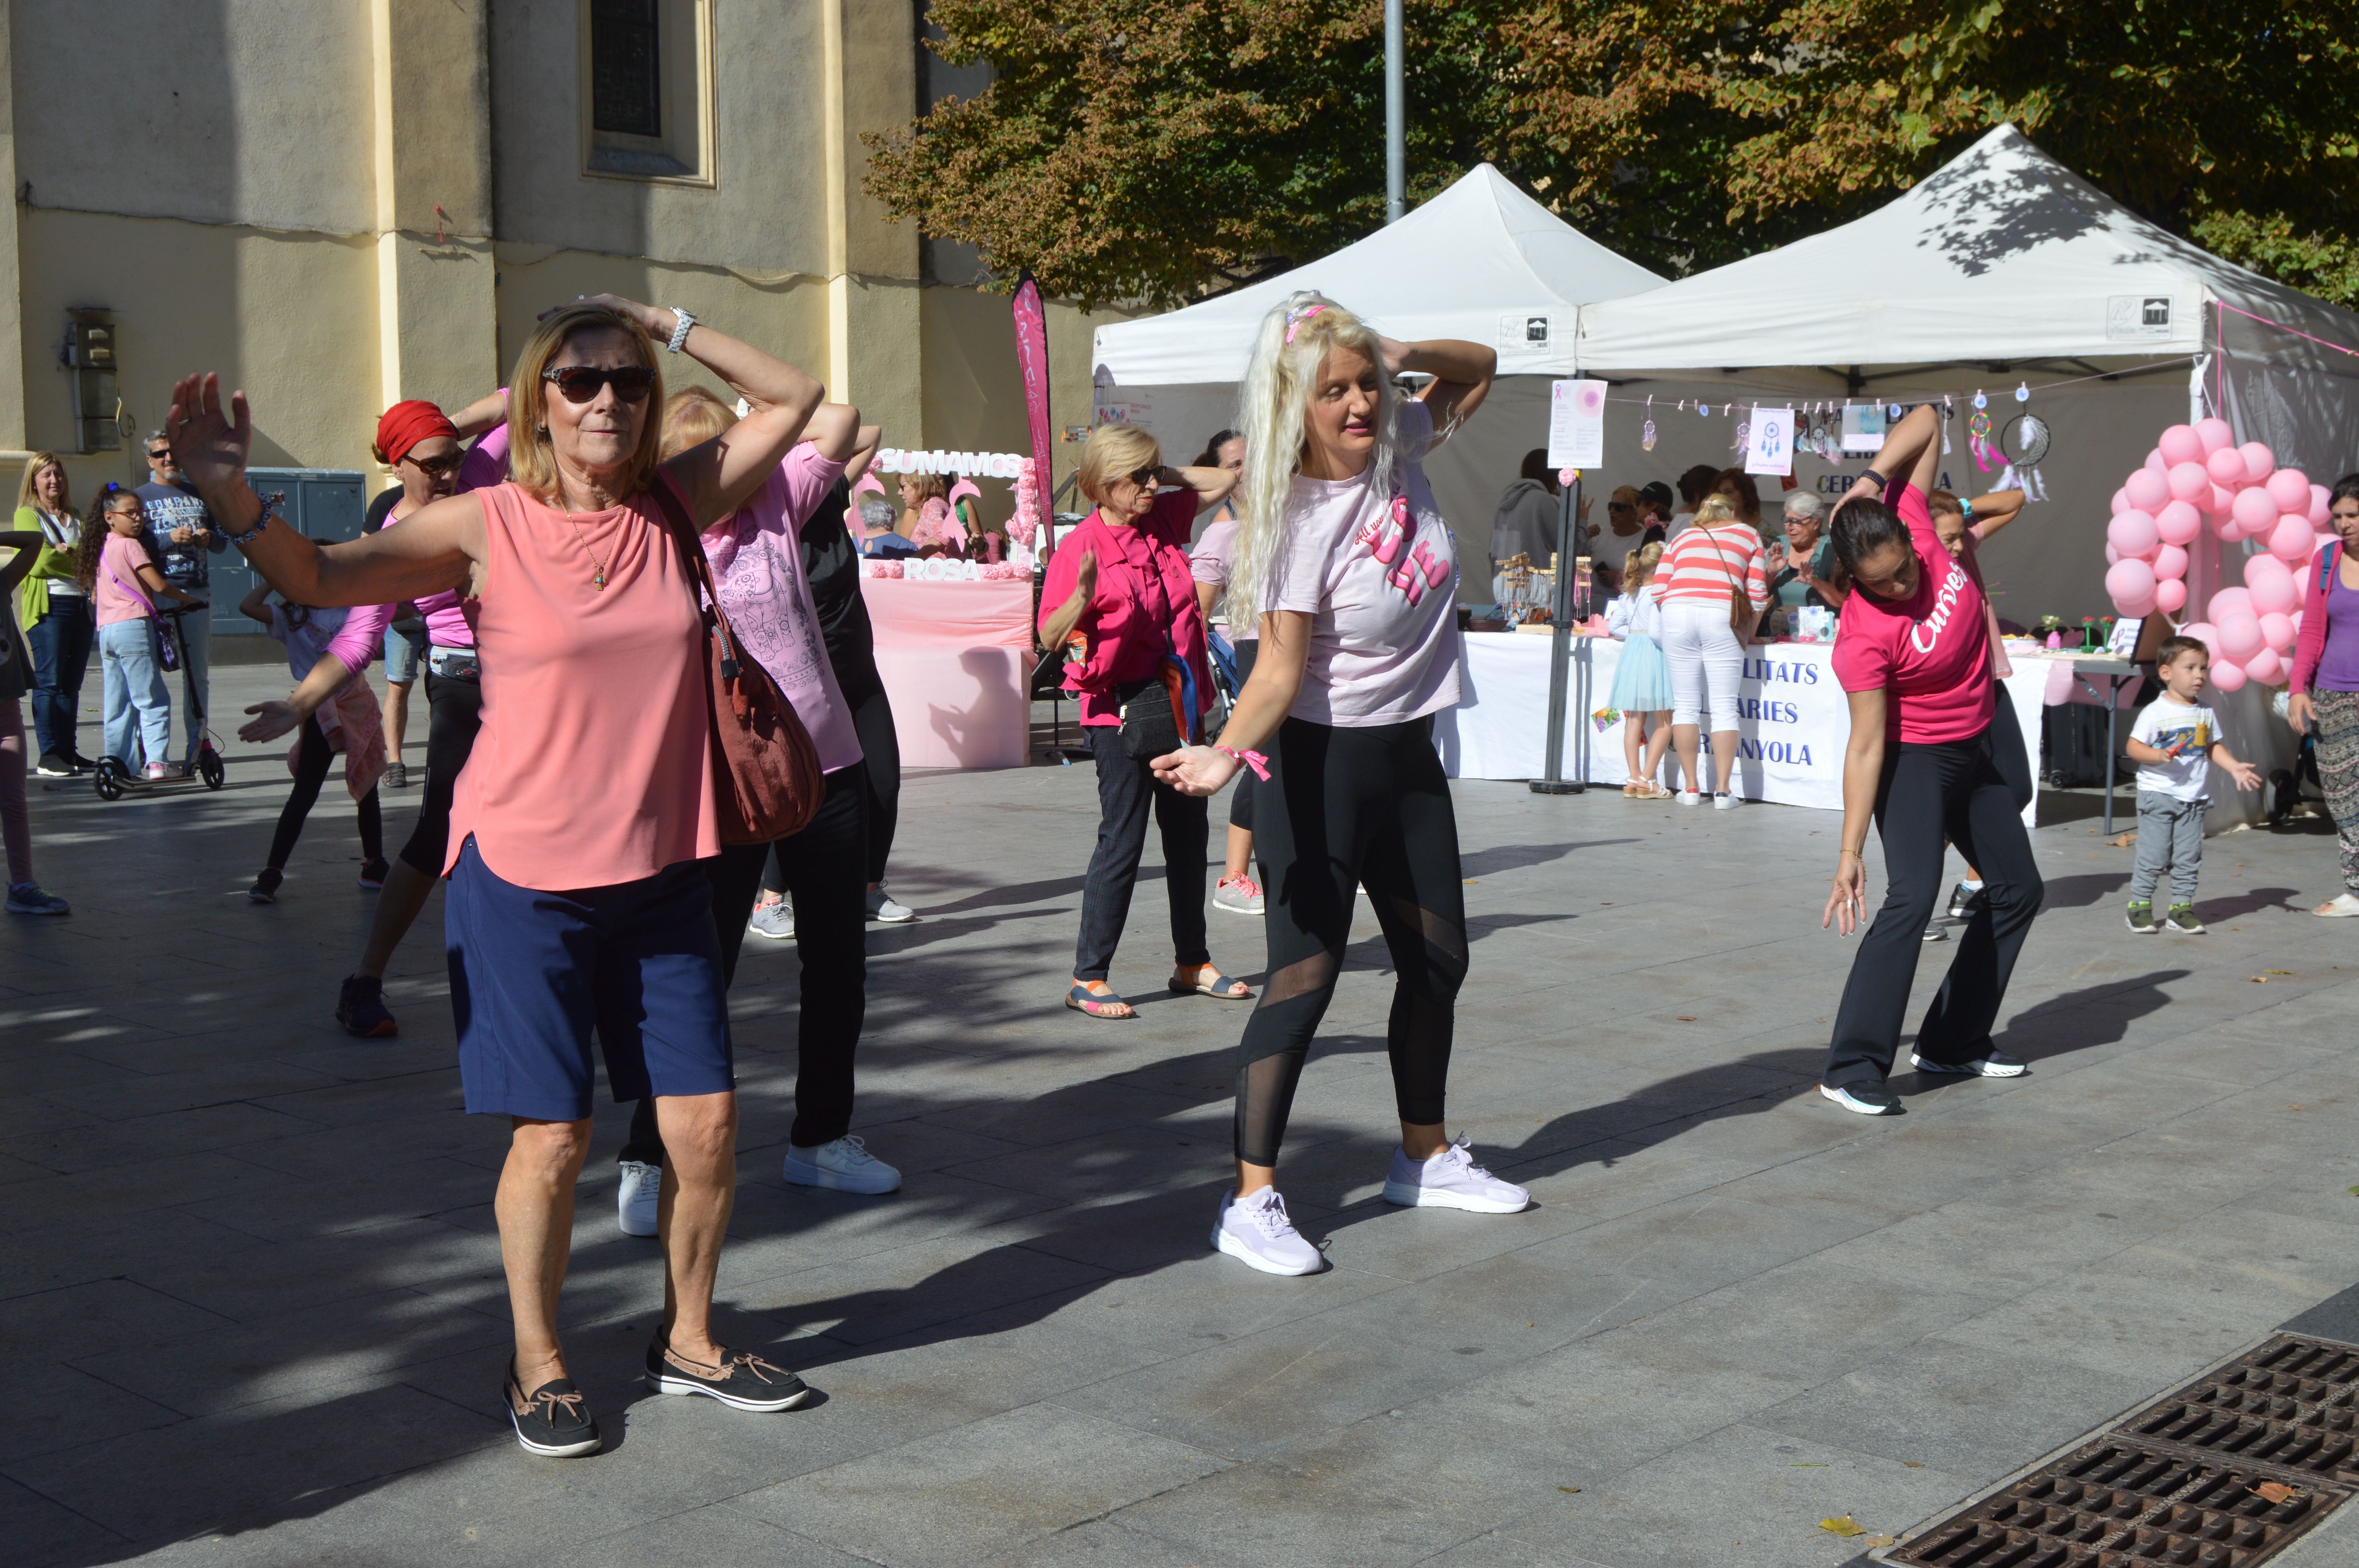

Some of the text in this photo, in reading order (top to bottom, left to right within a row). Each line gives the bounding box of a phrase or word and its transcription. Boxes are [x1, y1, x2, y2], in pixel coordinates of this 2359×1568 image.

[880, 448, 1023, 478] SUMAMOS
[1355, 526, 1370, 545] All
[904, 558, 981, 581] ROSA
[1911, 561, 1968, 653] Curves
[1743, 658, 1818, 685] LITATS
